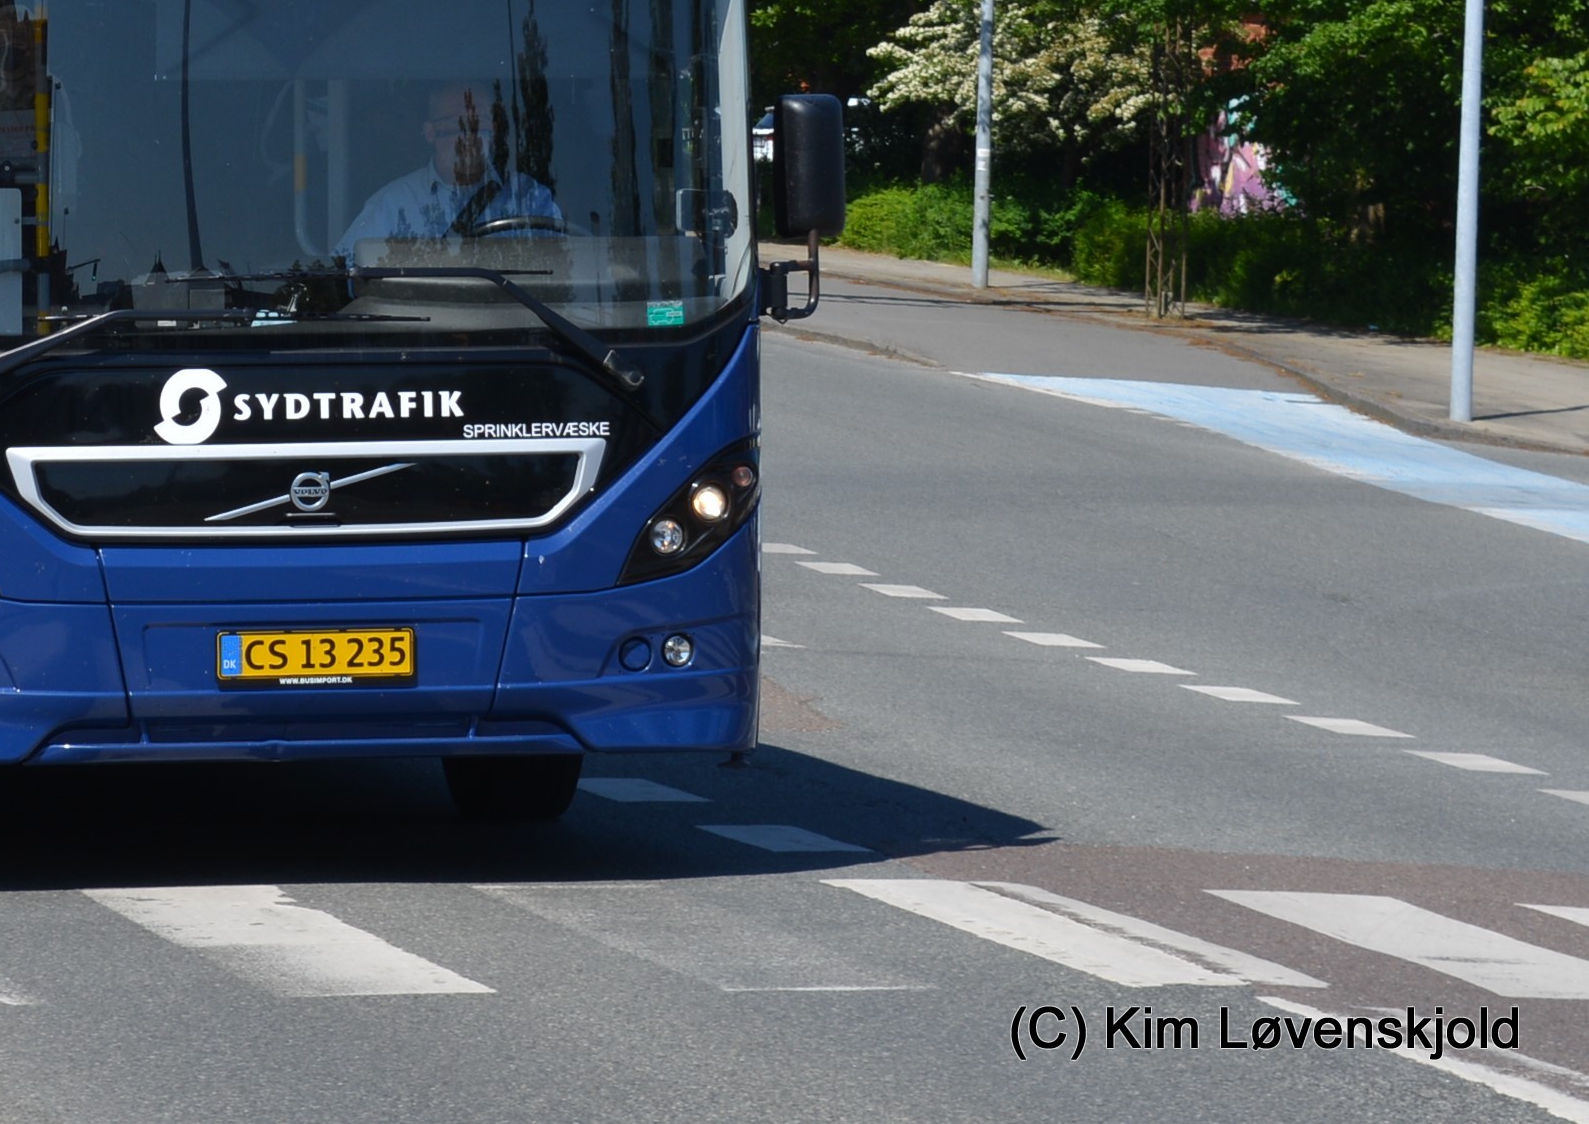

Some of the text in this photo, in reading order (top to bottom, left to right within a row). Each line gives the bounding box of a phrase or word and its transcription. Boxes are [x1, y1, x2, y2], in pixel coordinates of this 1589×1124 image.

[233, 391, 465, 420] SYDTRAFIK
[463, 421, 610, 438] SPRINKLERVÆSKE
[223, 636, 406, 670] DK CS 13 235
[279, 677, 353, 685] WWW.BUSIMPORT.DK
